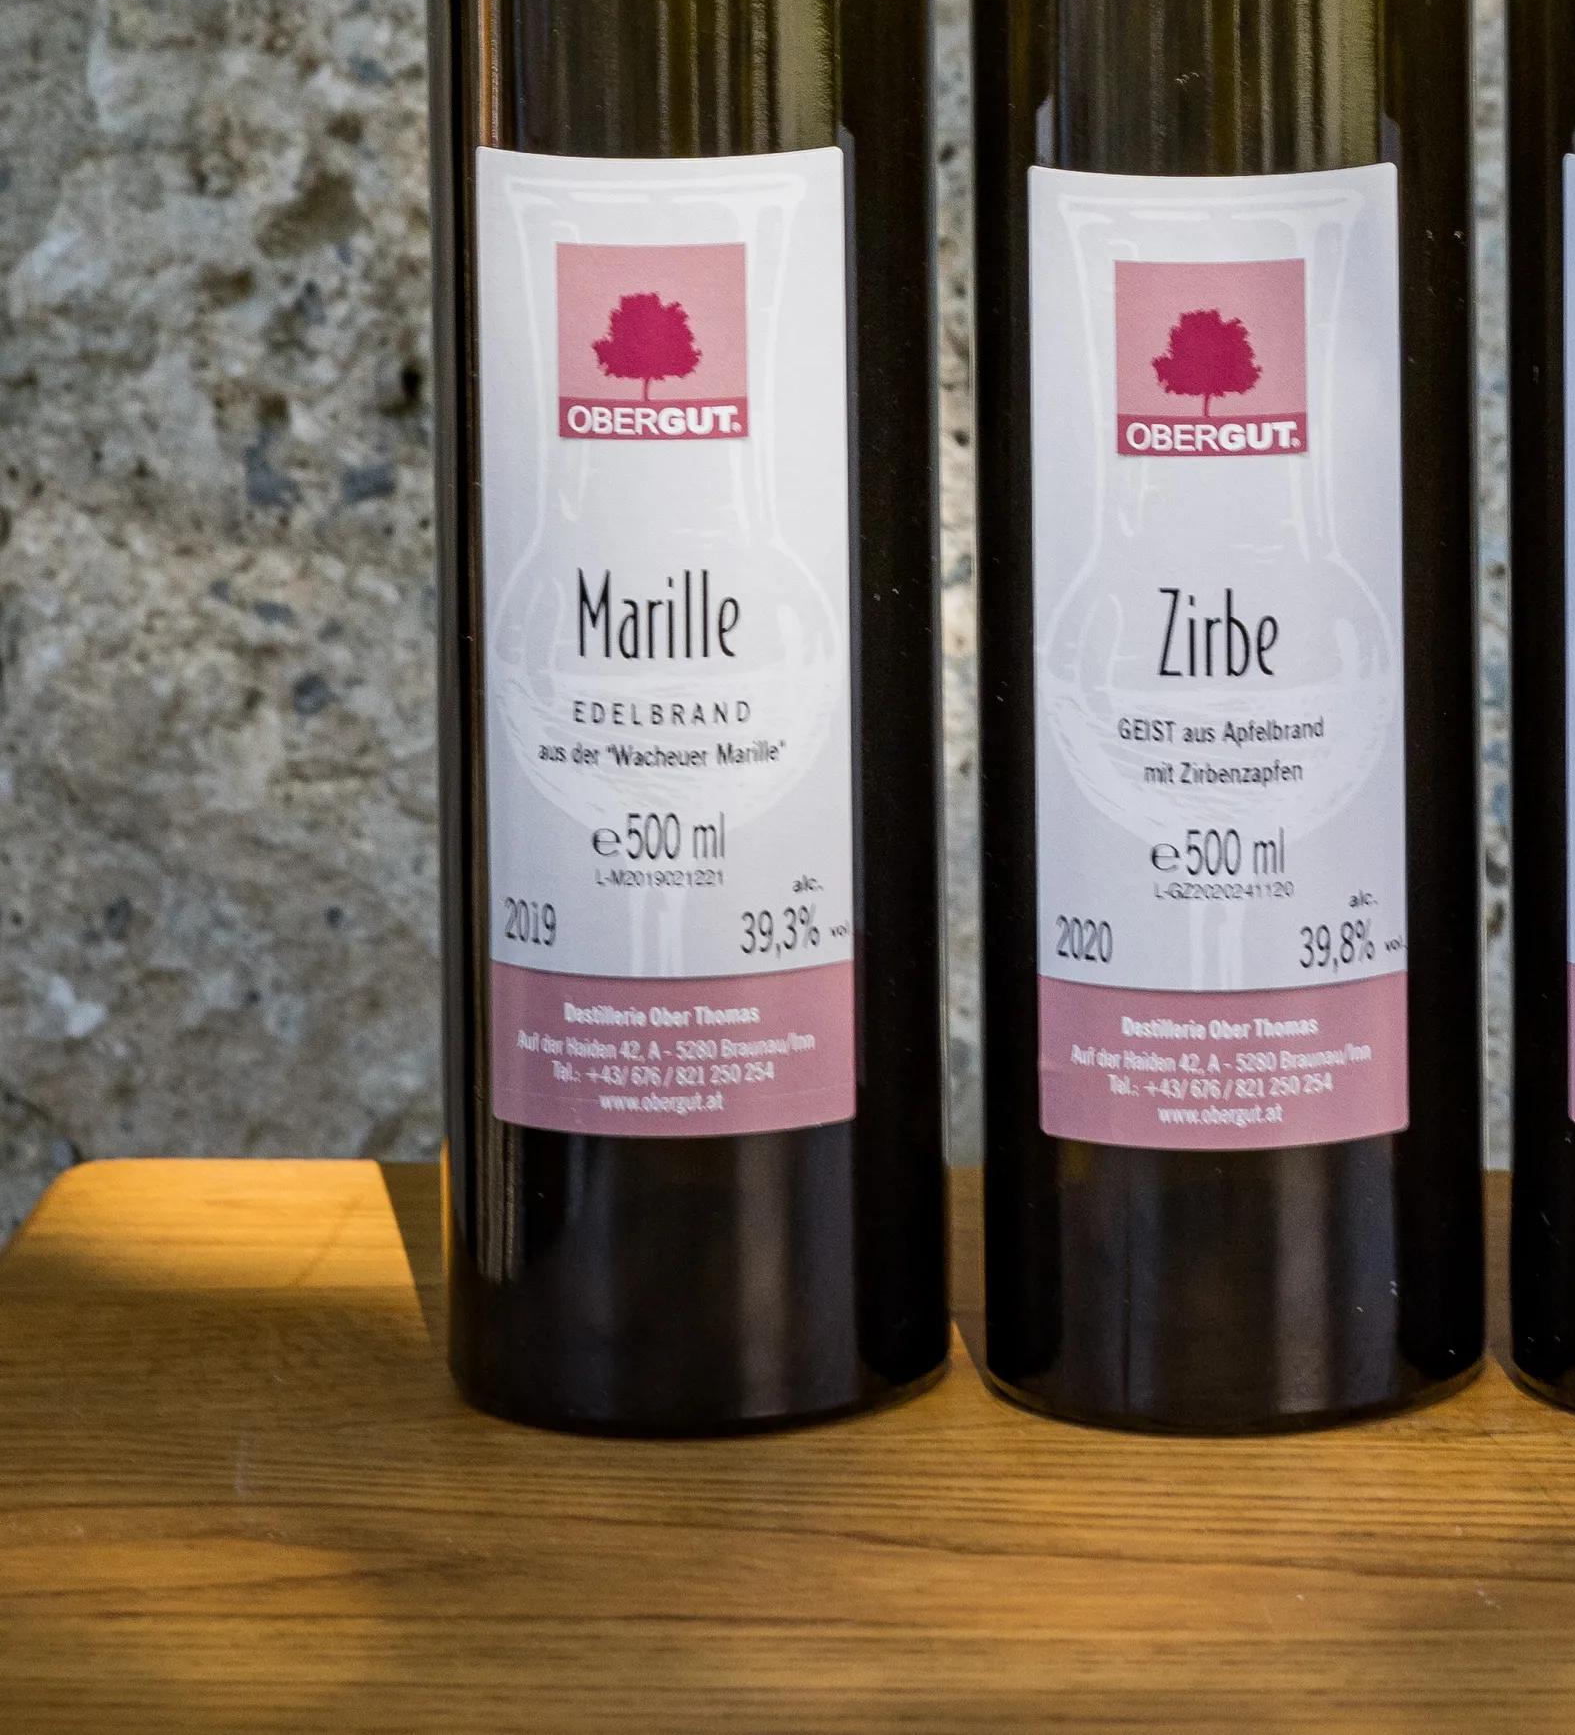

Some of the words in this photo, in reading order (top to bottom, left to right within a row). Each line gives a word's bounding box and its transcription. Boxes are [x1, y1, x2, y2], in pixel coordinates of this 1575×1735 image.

[577, 567, 739, 659] Marille
[1158, 587, 1278, 676] Zirbe
[572, 700, 751, 726] EDELBRAND
[1118, 717, 1176, 743] GEIST
[1182, 724, 1215, 743] aus
[1221, 716, 1325, 747] Apfelbrand
[538, 745, 566, 761] aus
[572, 743, 599, 764] der
[1144, 763, 1174, 784] mit
[1180, 760, 1303, 787] Zirbenzapfen
[692, 812, 725, 859] ml
[1253, 827, 1284, 873] ml
[504, 897, 556, 946] 2019
[741, 903, 820, 958] 39,3%
[1056, 915, 1113, 964] 2020
[1299, 918, 1376, 973] 39,8%
[694, 1006, 759, 1026] Thomas
[1253, 1017, 1319, 1038] Thomas
